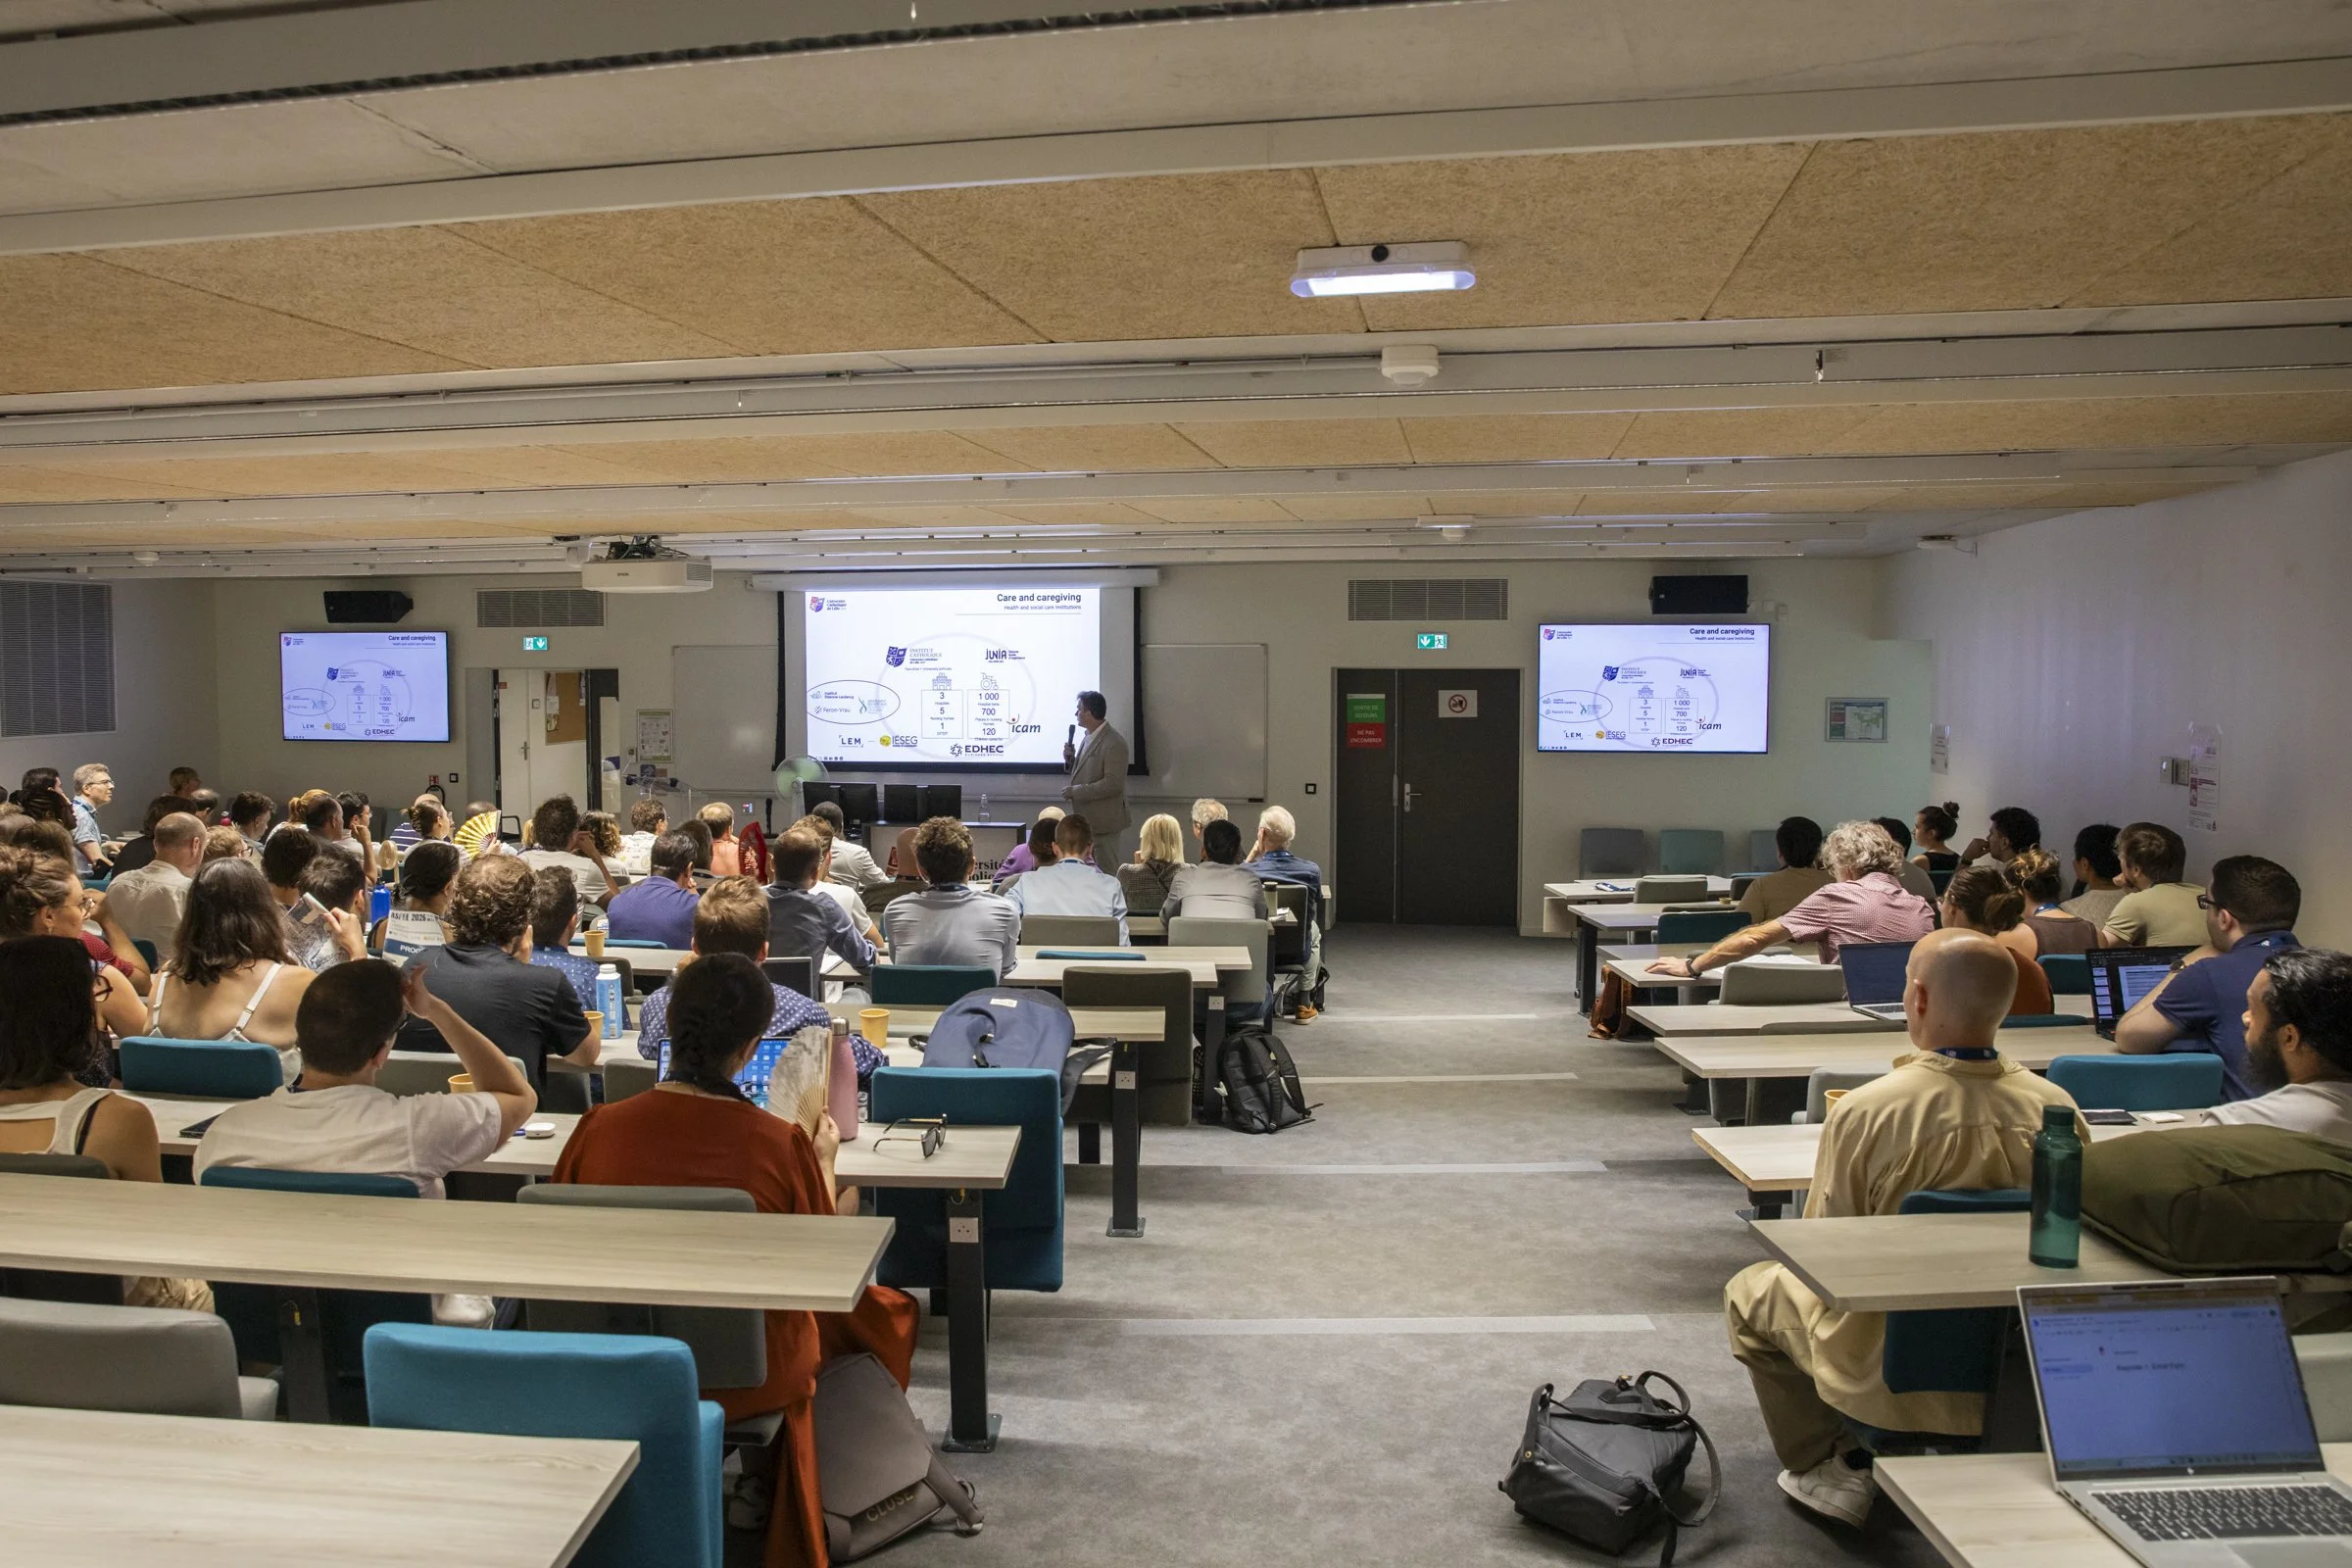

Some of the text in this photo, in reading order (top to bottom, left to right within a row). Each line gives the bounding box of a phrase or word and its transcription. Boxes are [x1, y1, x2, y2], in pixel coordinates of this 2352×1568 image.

[997, 592, 1082, 603] Care and caregiving
[1720, 627, 1755, 636] caregiving
[985, 692, 1000, 701] 000
[982, 708, 996, 716] 700
[982, 727, 997, 736] 120
[1011, 724, 1041, 733] icam
[964, 745, 1004, 754] EDHEC
[411, 912, 427, 921] 2026
